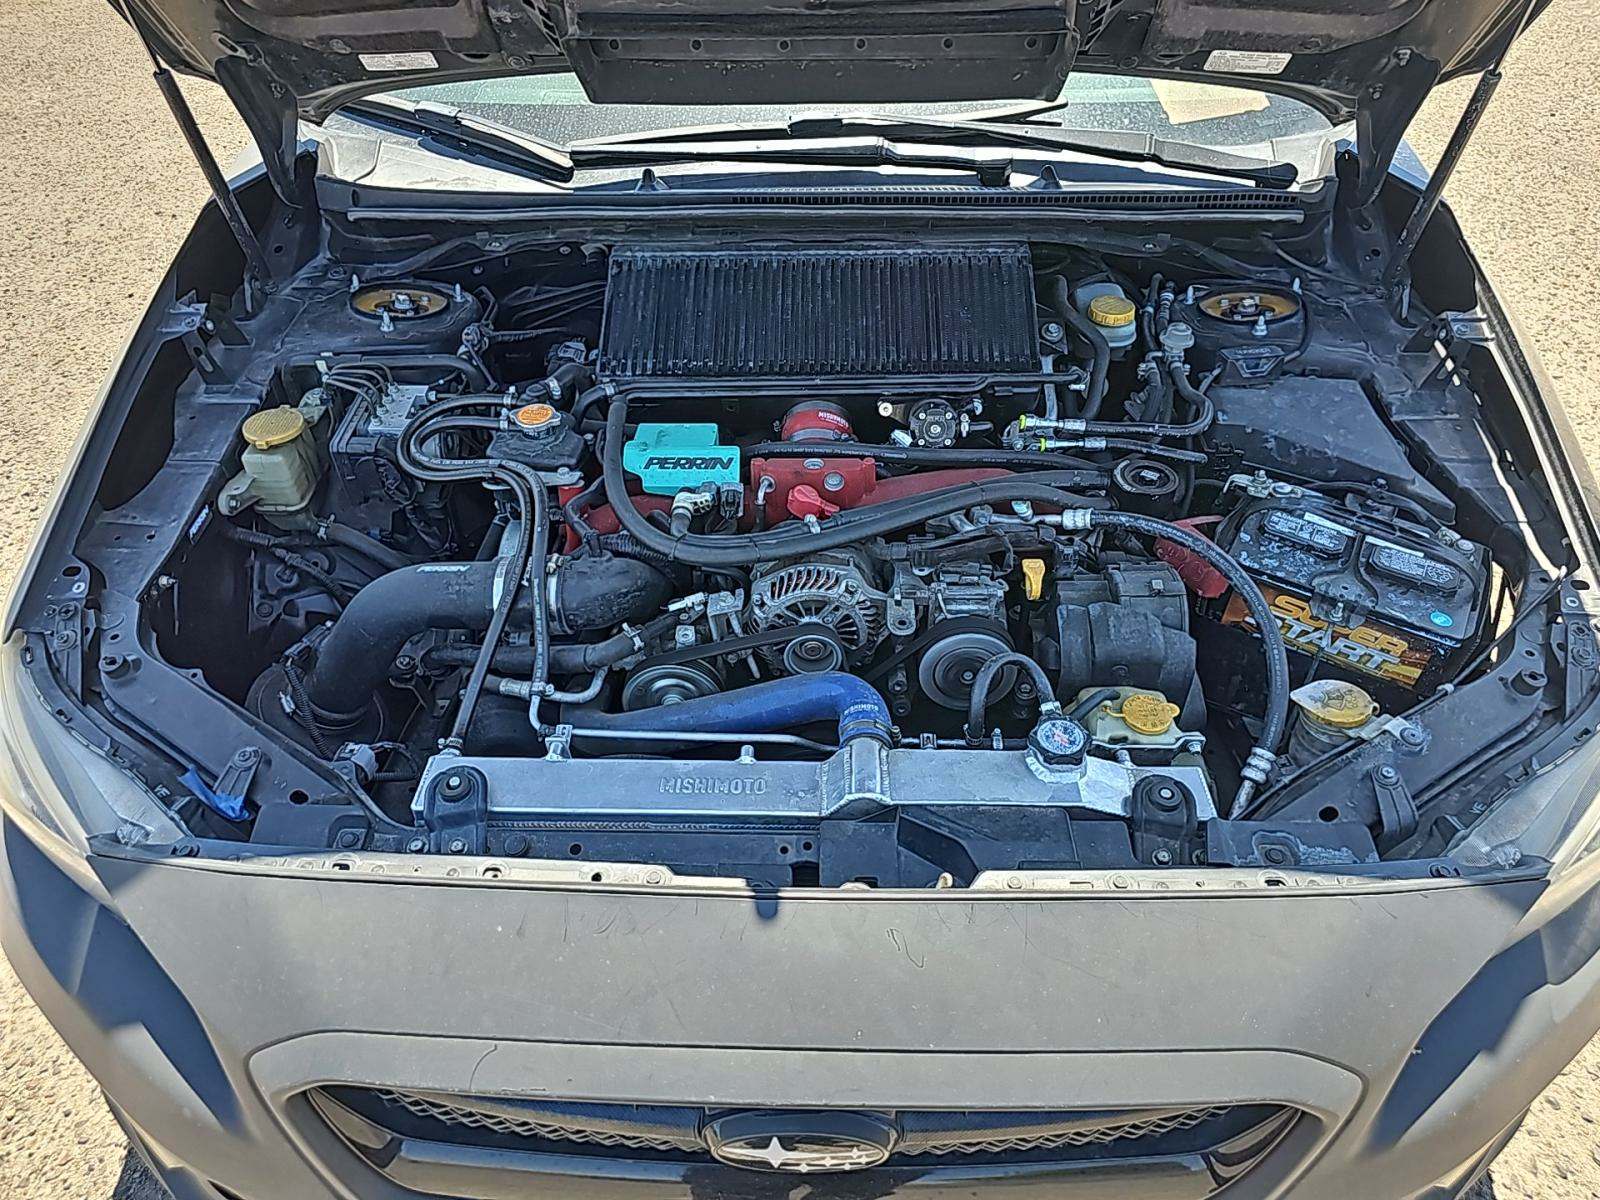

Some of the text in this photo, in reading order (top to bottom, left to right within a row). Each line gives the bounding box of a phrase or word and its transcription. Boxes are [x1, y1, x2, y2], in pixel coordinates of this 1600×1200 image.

[643, 456, 735, 470] PERRIN
[1269, 595, 1408, 658] SUER
[659, 777, 767, 794] MISHIMOTO
